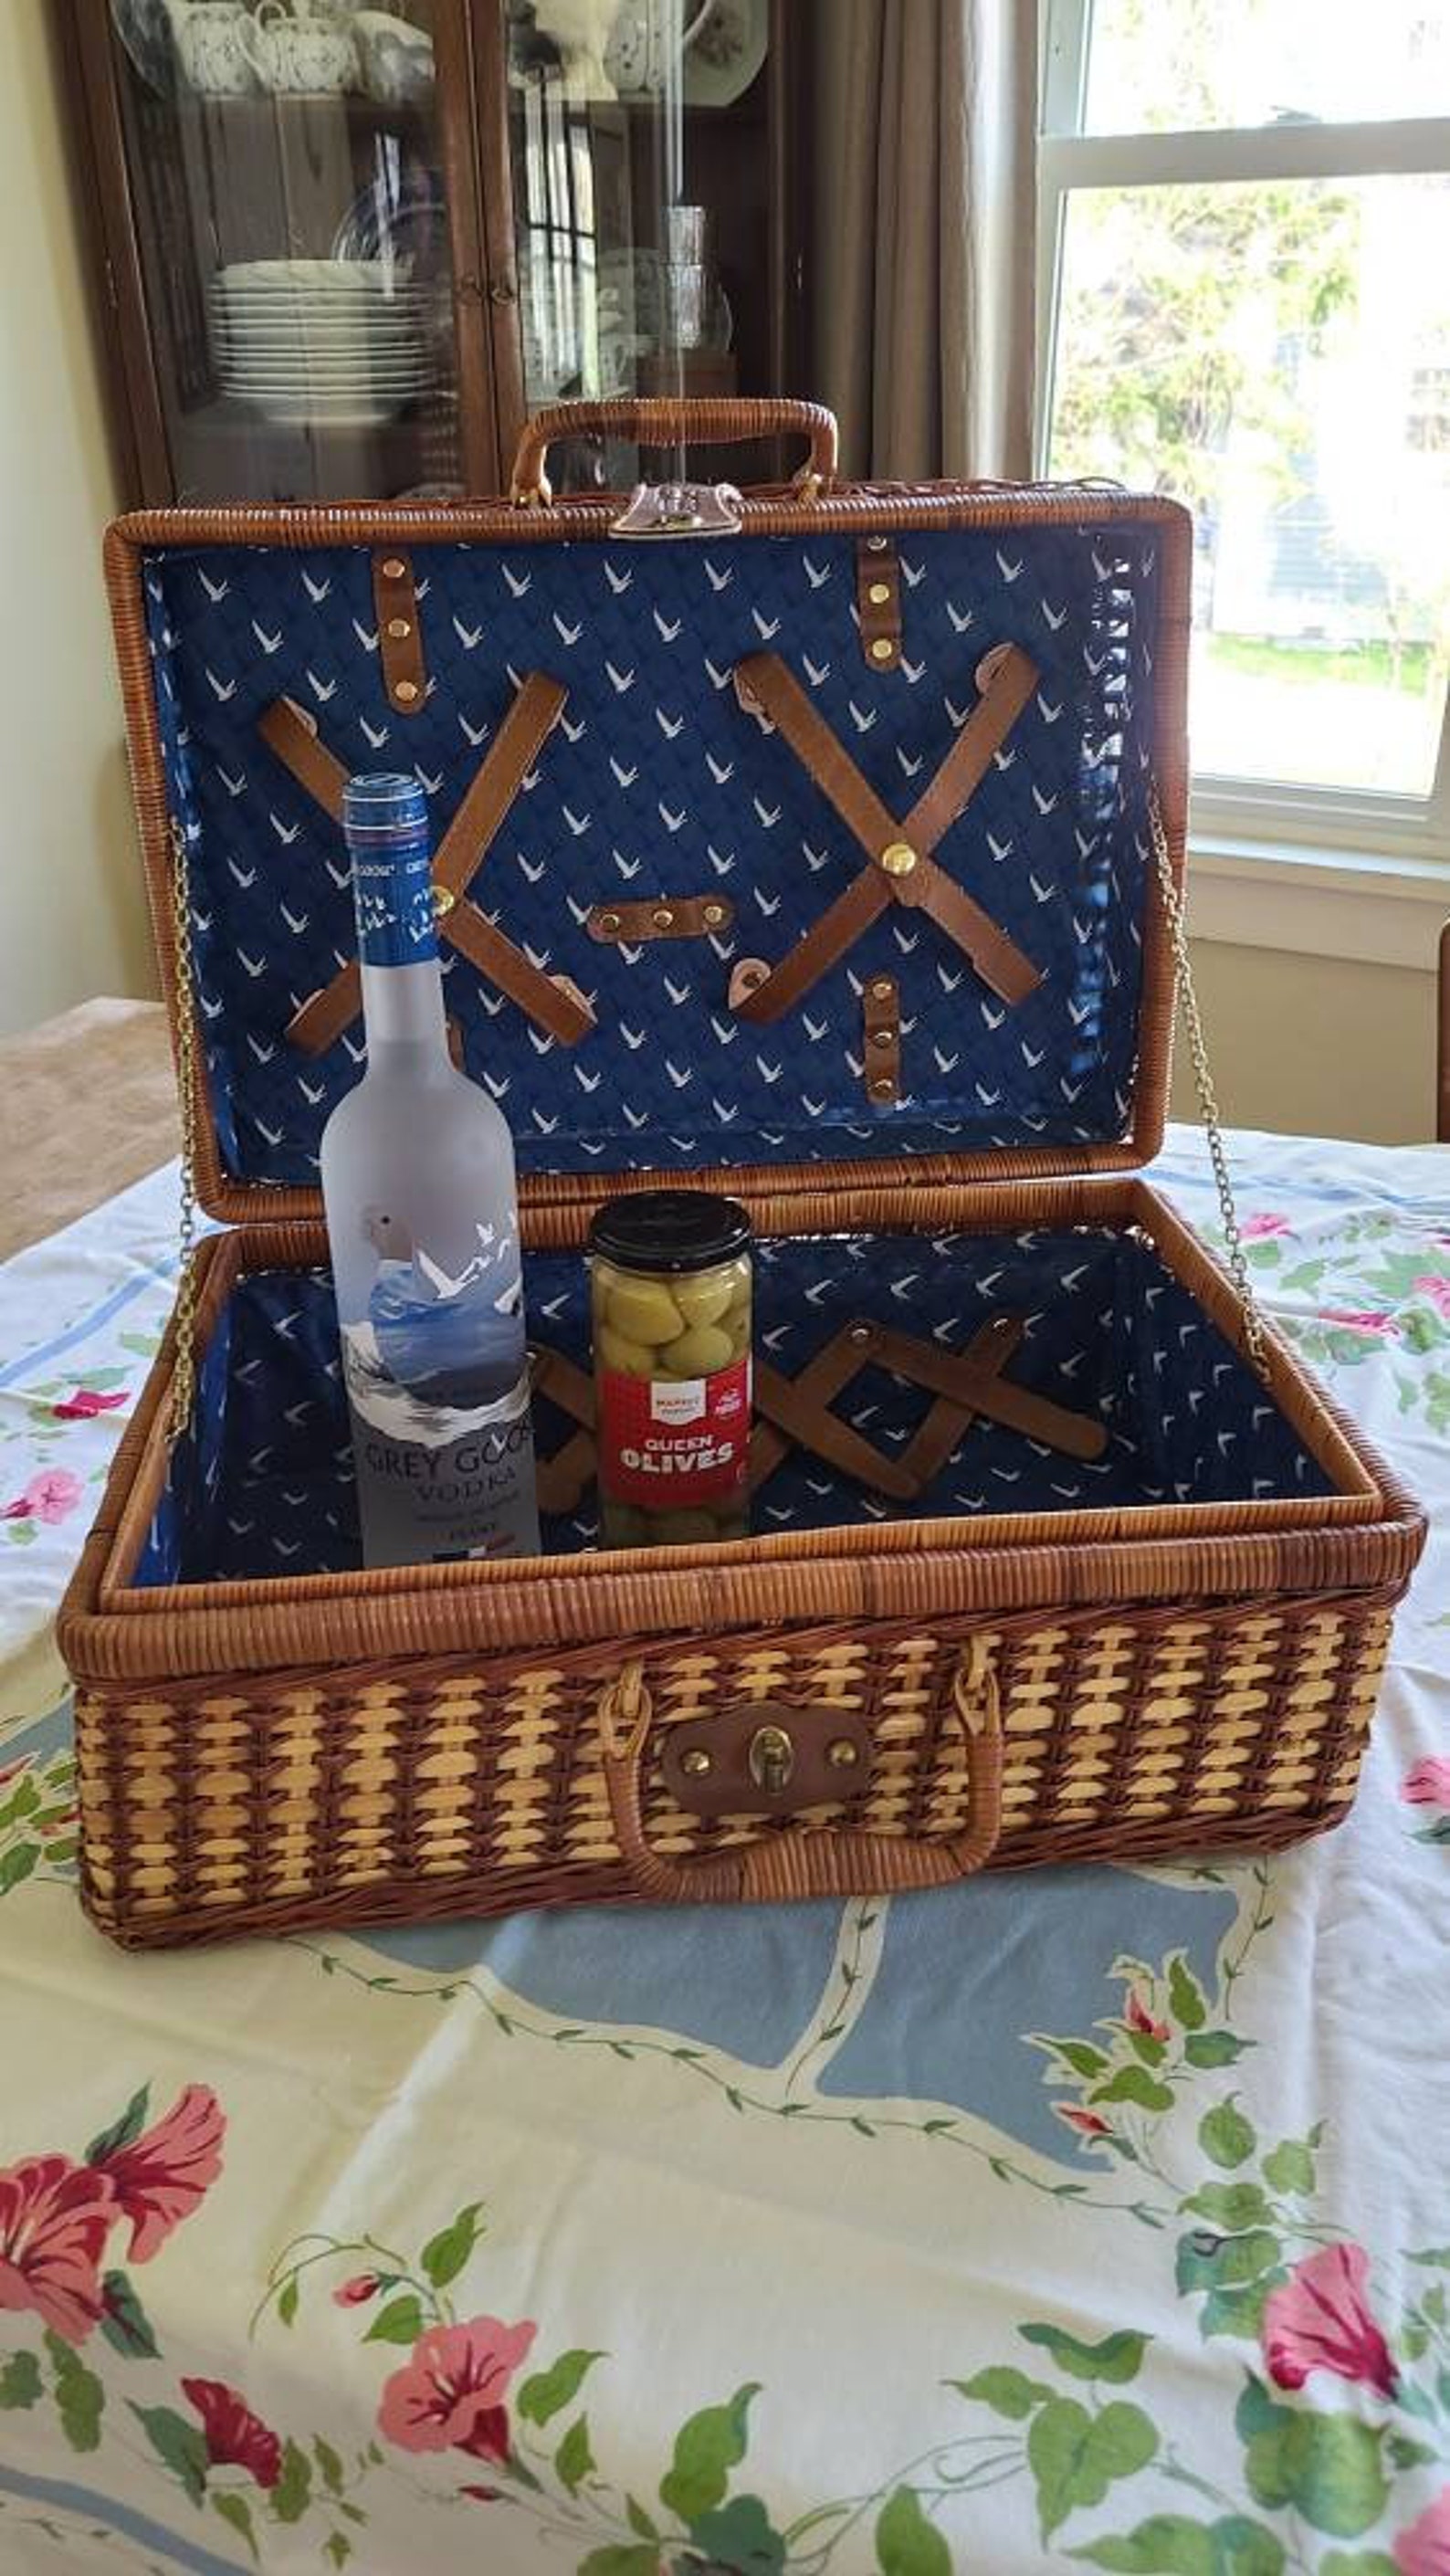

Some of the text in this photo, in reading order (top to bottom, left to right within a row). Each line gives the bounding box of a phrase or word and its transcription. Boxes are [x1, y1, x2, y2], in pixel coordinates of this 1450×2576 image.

[620, 1442, 733, 1474] OLIVES
[645, 1435, 714, 1451] QUEEN
[366, 1444, 441, 1479] GREY
[416, 1465, 516, 1502] VODKA
